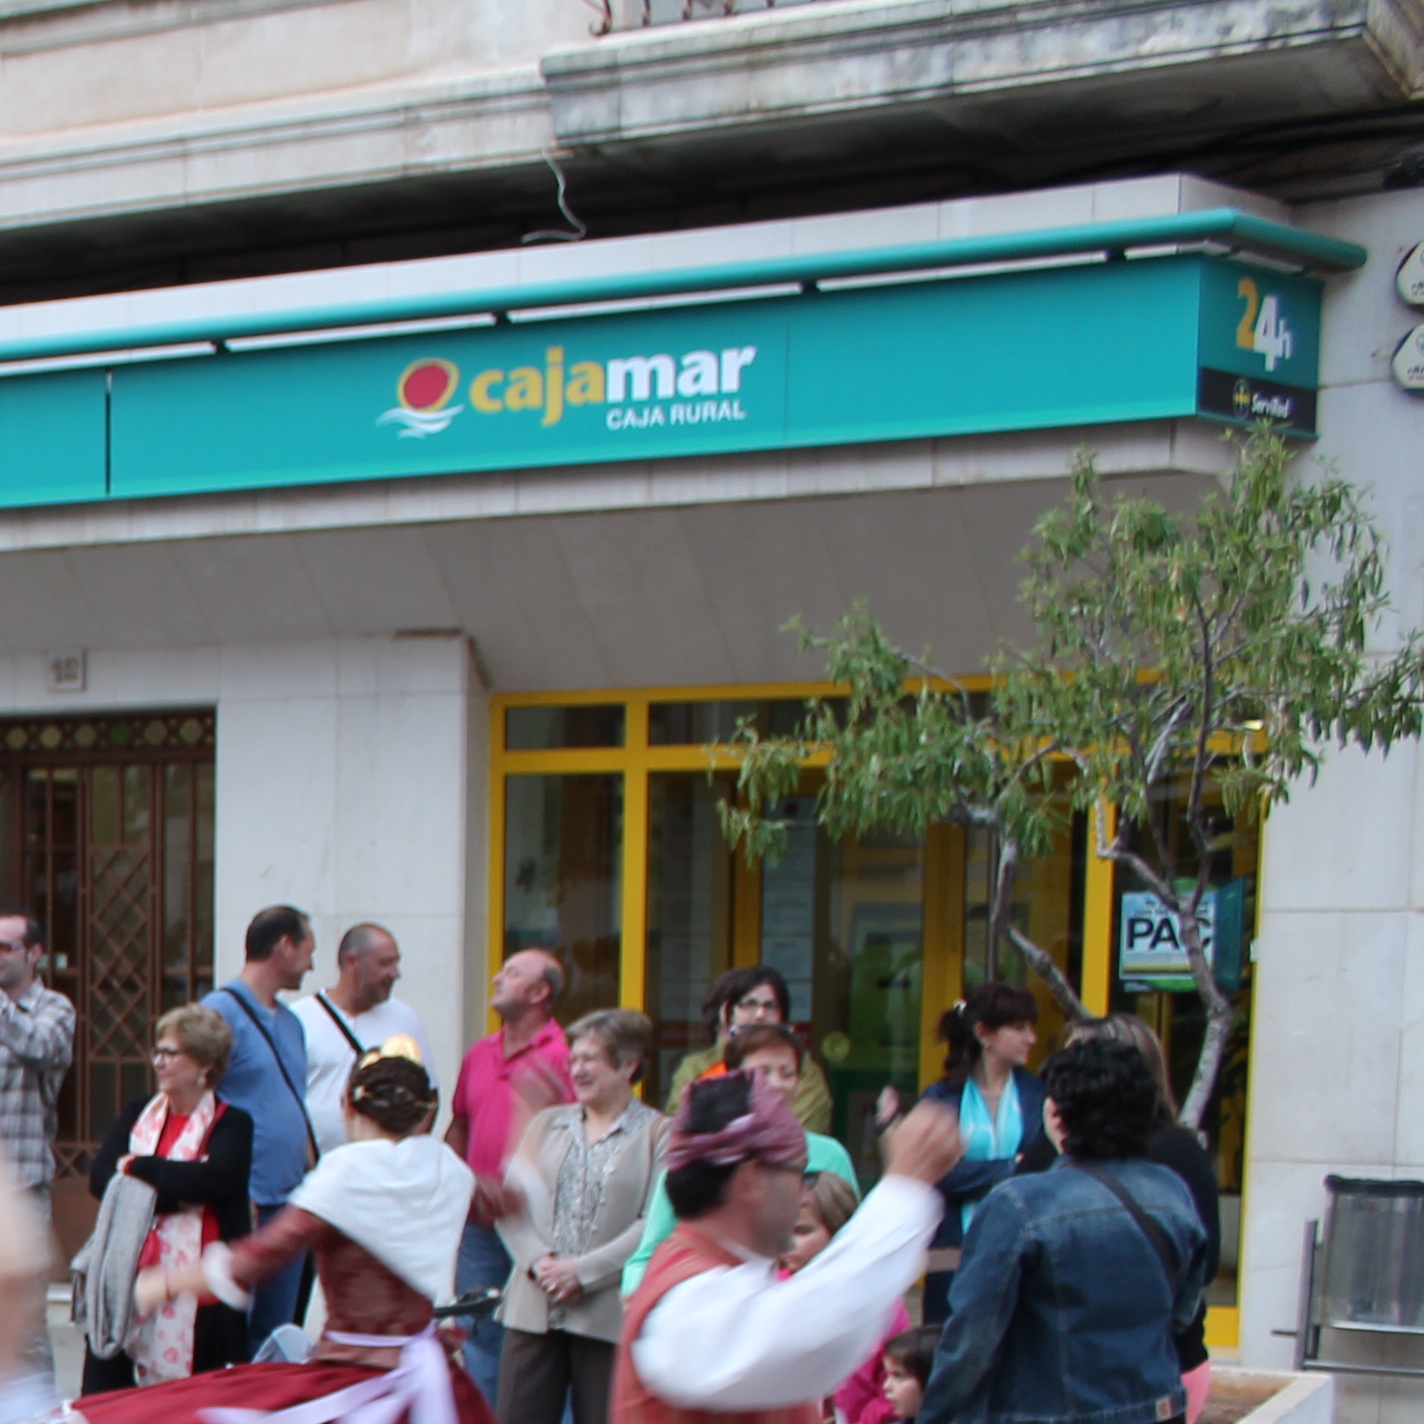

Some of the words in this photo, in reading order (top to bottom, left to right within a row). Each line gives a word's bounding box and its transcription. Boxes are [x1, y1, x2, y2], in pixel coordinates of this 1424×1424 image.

[1235, 276, 1293, 372] 24h
[469, 345, 756, 428] cajamar
[606, 406, 665, 431] CAJA
[669, 399, 746, 426] RURAL
